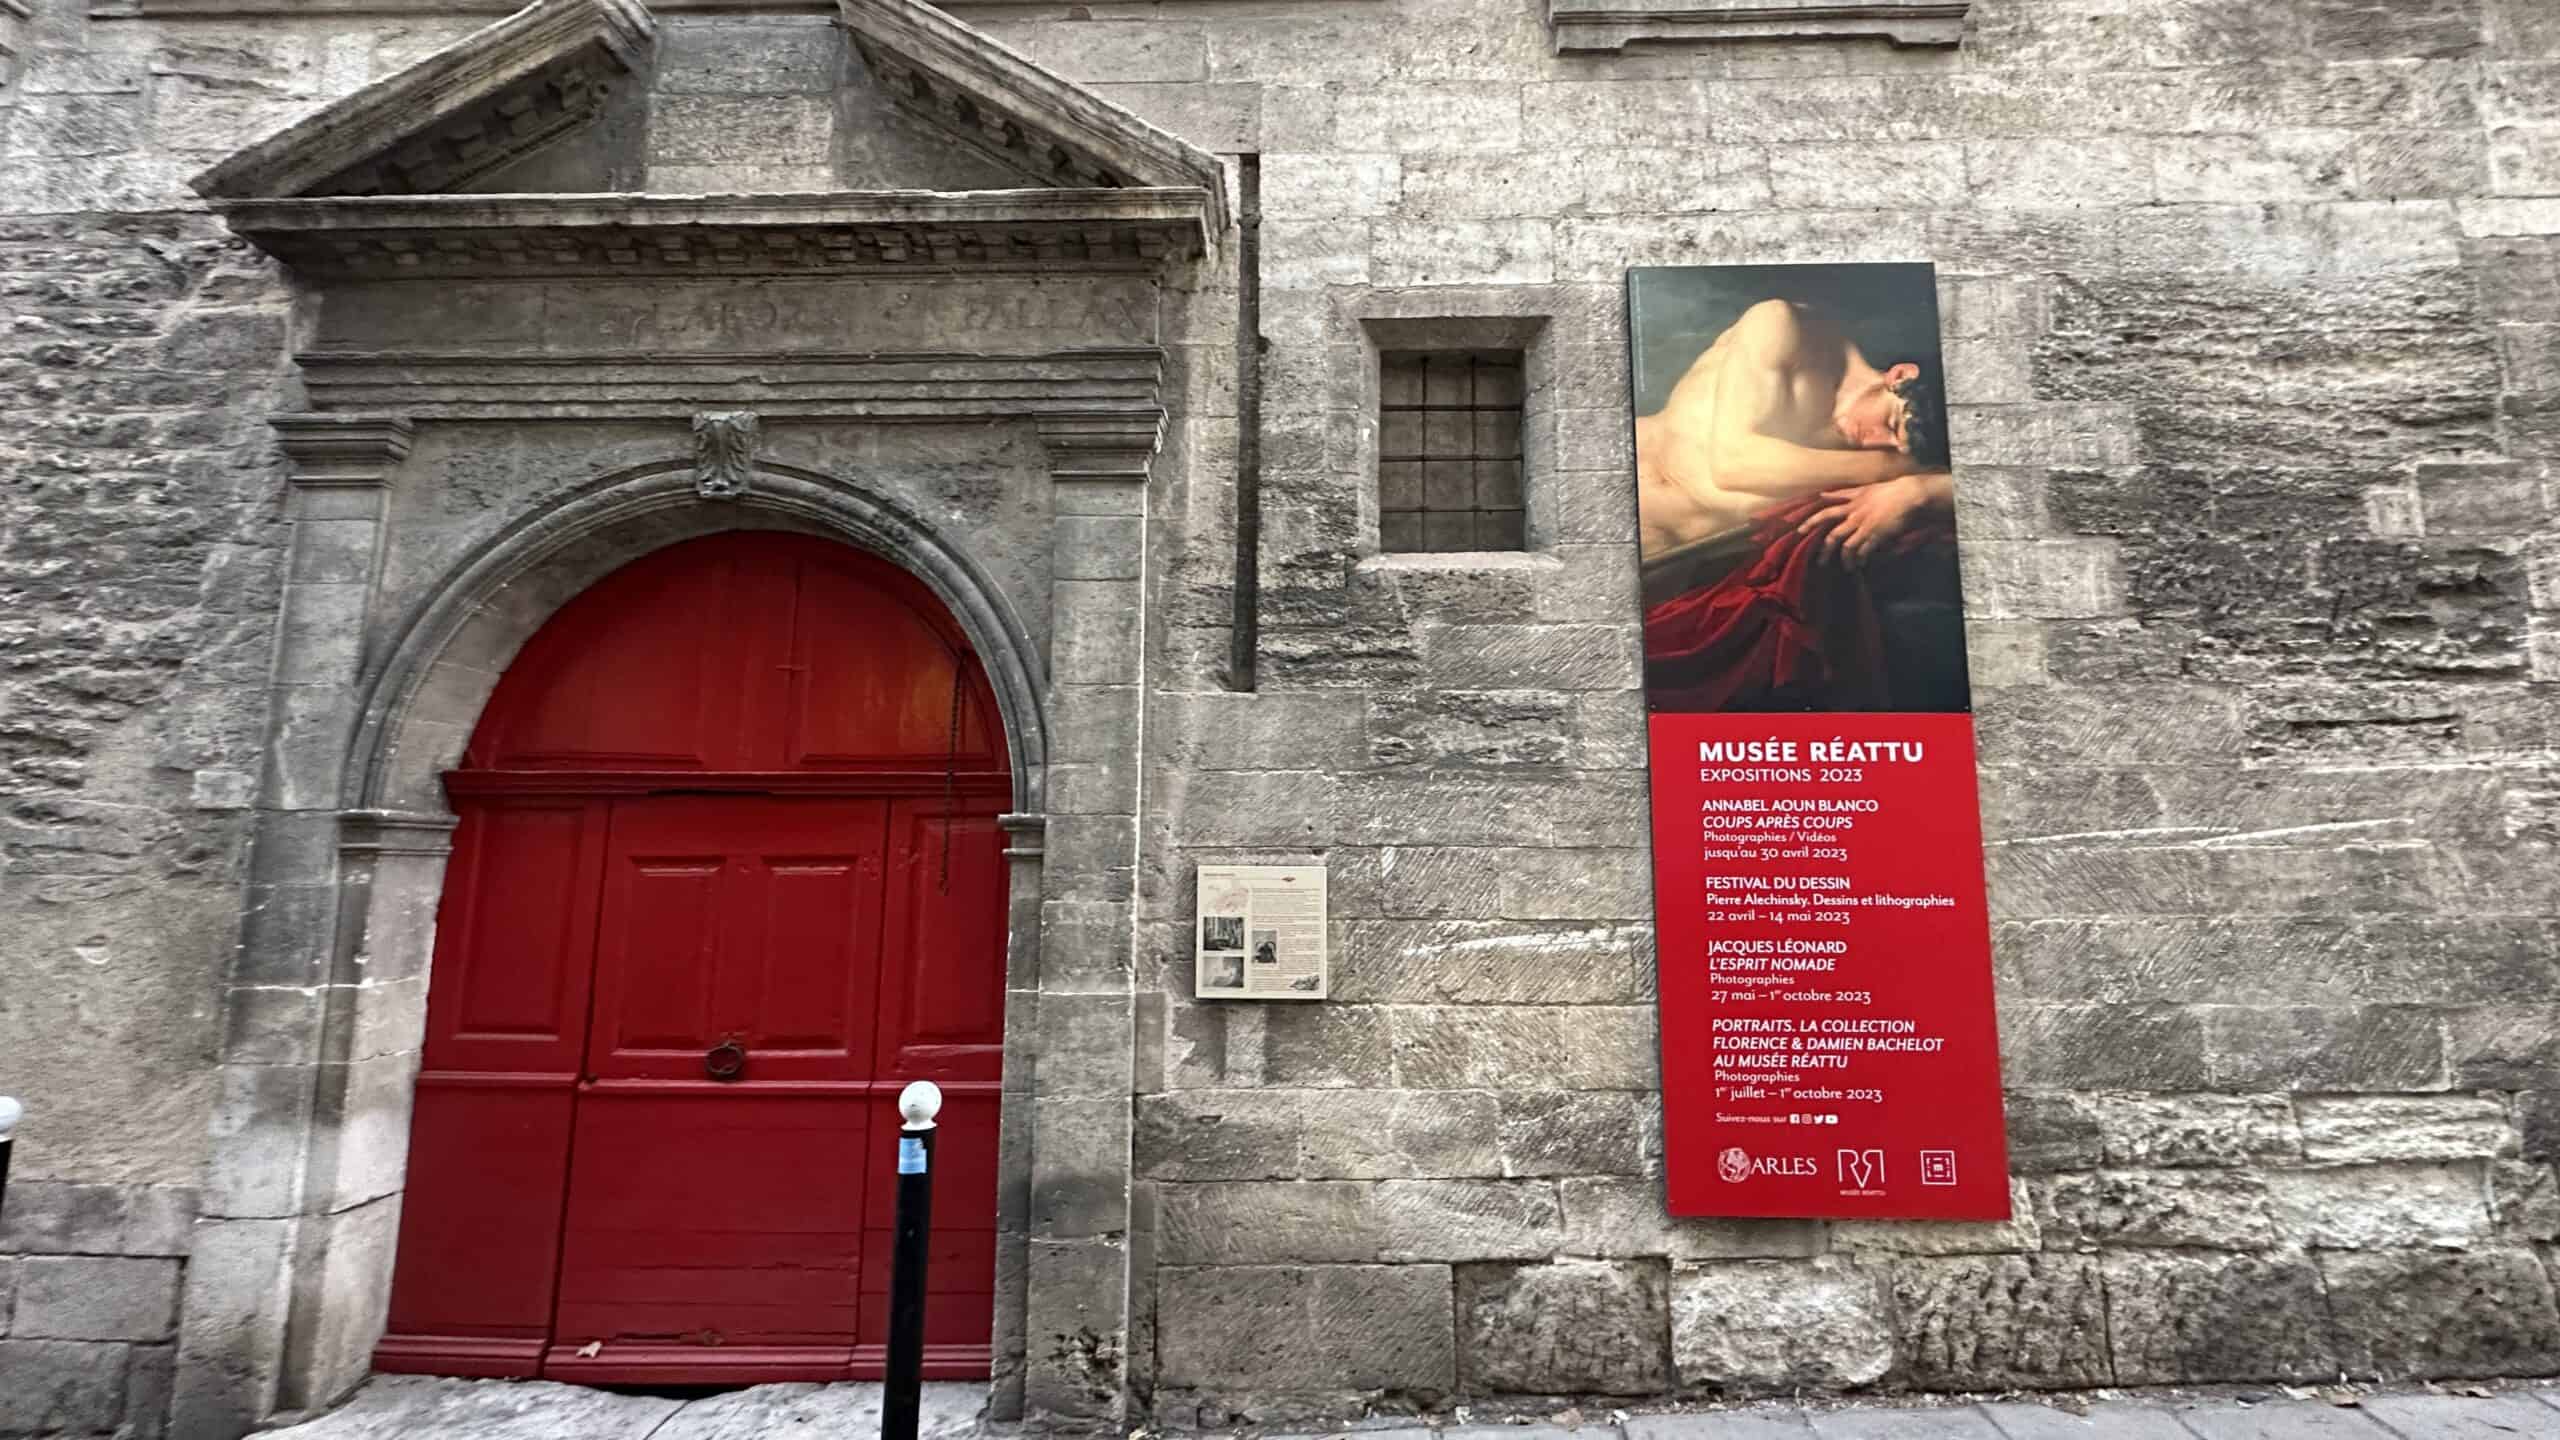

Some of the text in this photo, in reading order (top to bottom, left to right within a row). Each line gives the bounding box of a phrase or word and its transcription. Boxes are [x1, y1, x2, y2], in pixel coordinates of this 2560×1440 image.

[1699, 735, 1924, 763] MUSÉE RÉATTU
[1700, 767, 1863, 783] EXPOSITIONS 2023
[1701, 799, 1879, 813] ANNABEL AOUN BLANCO
[1702, 813, 1853, 830] COUPS APRÈS COUPS
[1703, 830, 1788, 845] Photographies
[1796, 830, 1837, 843] Vidéos
[1703, 845, 1848, 862] jusqu'au 30 avril 2023
[1705, 876, 1851, 890] FESTIVAL DU DESSIN
[1706, 892, 1956, 909] Pierre Alechinsky. Dessins et lithographies
[1707, 911, 1725, 921] 22
[1727, 908, 1756, 921] avril
[1769, 911, 1785, 925] 14
[1786, 910, 1812, 922] mai
[1814, 911, 1851, 925] 2023
[1707, 937, 1848, 957] JACQUES LÉONARD
[1709, 957, 1837, 972] L'ESPRIT NOMADE
[1710, 972, 1795, 988] Photographies
[1711, 990, 1728, 1004] 27
[1731, 989, 1756, 1001] mai
[1782, 988, 1833, 1002] octobre
[1835, 991, 1872, 1005] 2023
[1712, 1018, 1915, 1034] PORTRAITS. LA COLLECTION
[1712, 1036, 1945, 1052] FLORENCE & DAMIEN BACHELOT
[1712, 1051, 1849, 1069] AU MUSÉE RÉATTU
[1714, 1069, 1800, 1085] Photographies
[1730, 1085, 1766, 1102] juillet
[1792, 1086, 1843, 1100] octobre
[1846, 1088, 1883, 1103] 2023
[1750, 1157, 1818, 1176] ARLES
